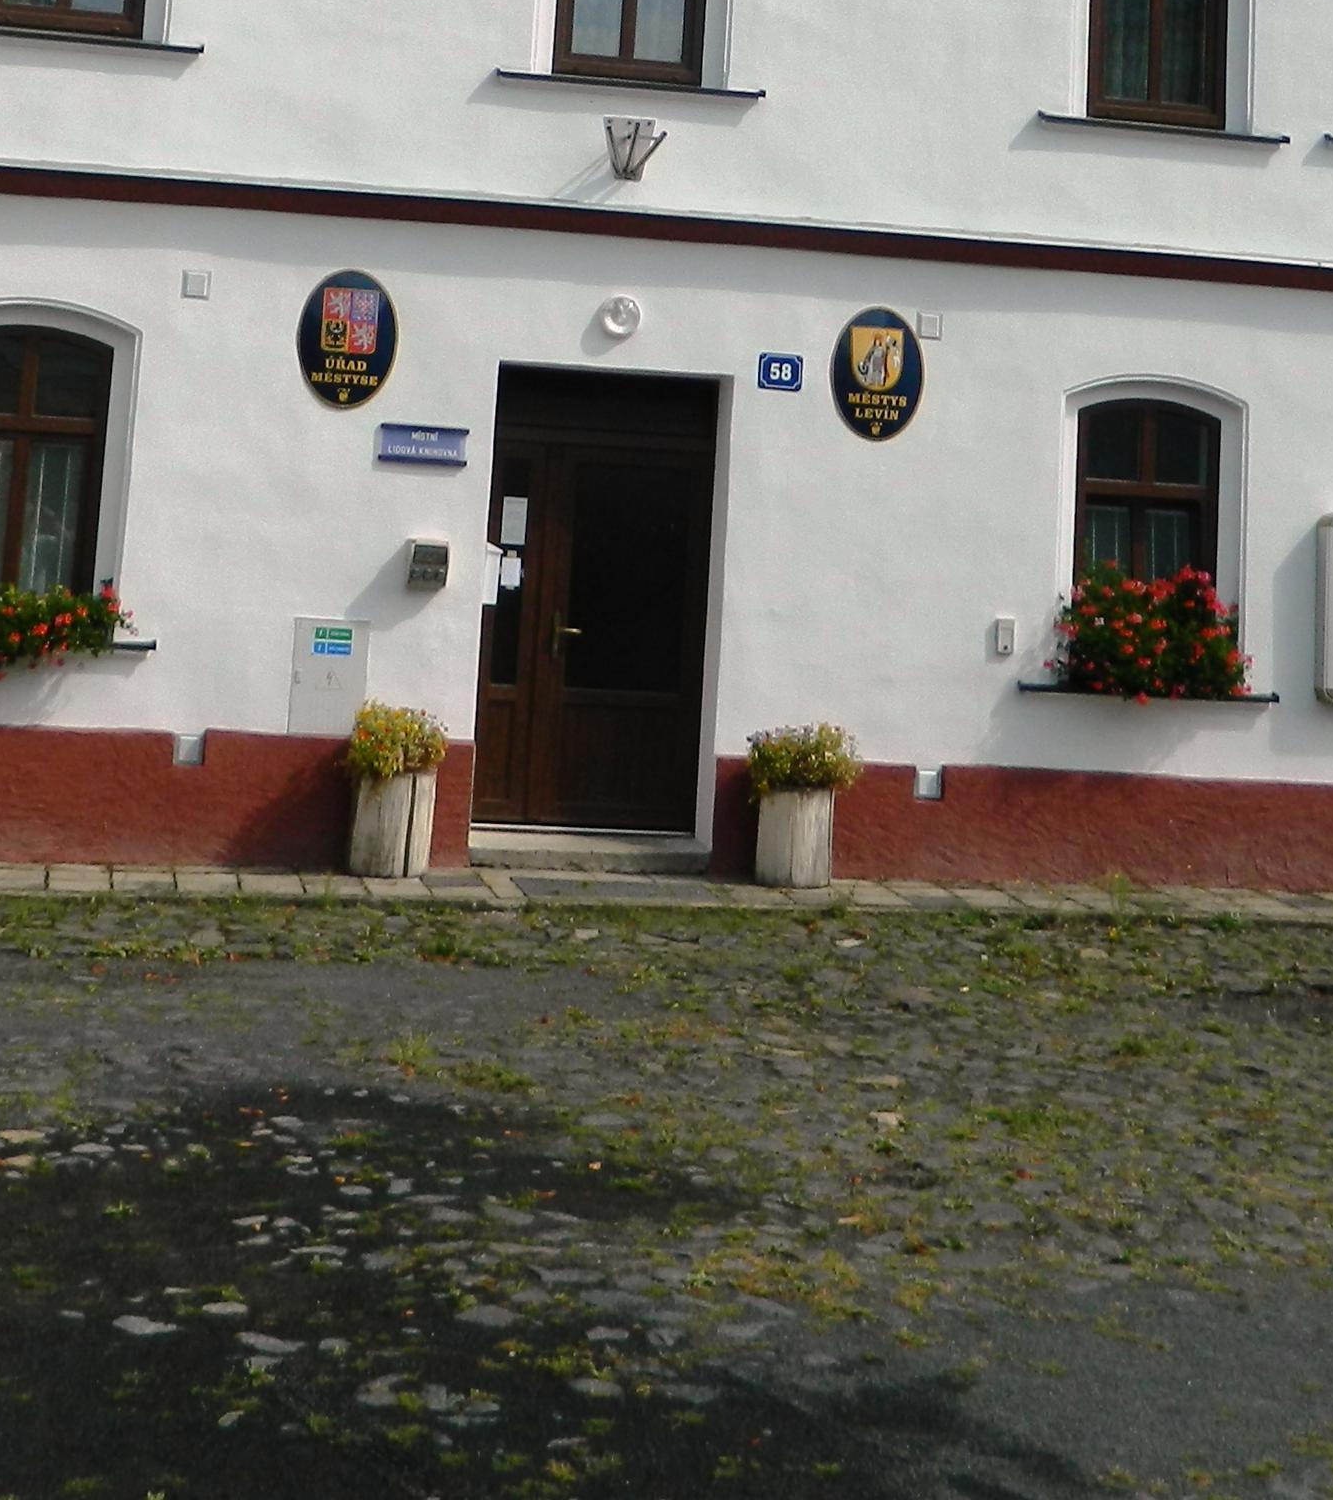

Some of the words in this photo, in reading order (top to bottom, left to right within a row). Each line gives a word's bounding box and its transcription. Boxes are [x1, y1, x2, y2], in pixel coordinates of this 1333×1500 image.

[325, 355, 367, 371] ÚŘAD
[311, 371, 378, 386] MĚSTYSE
[770, 362, 792, 381] 58
[848, 391, 907, 407] MĚSTYS
[855, 406, 899, 420] LEVÍN
